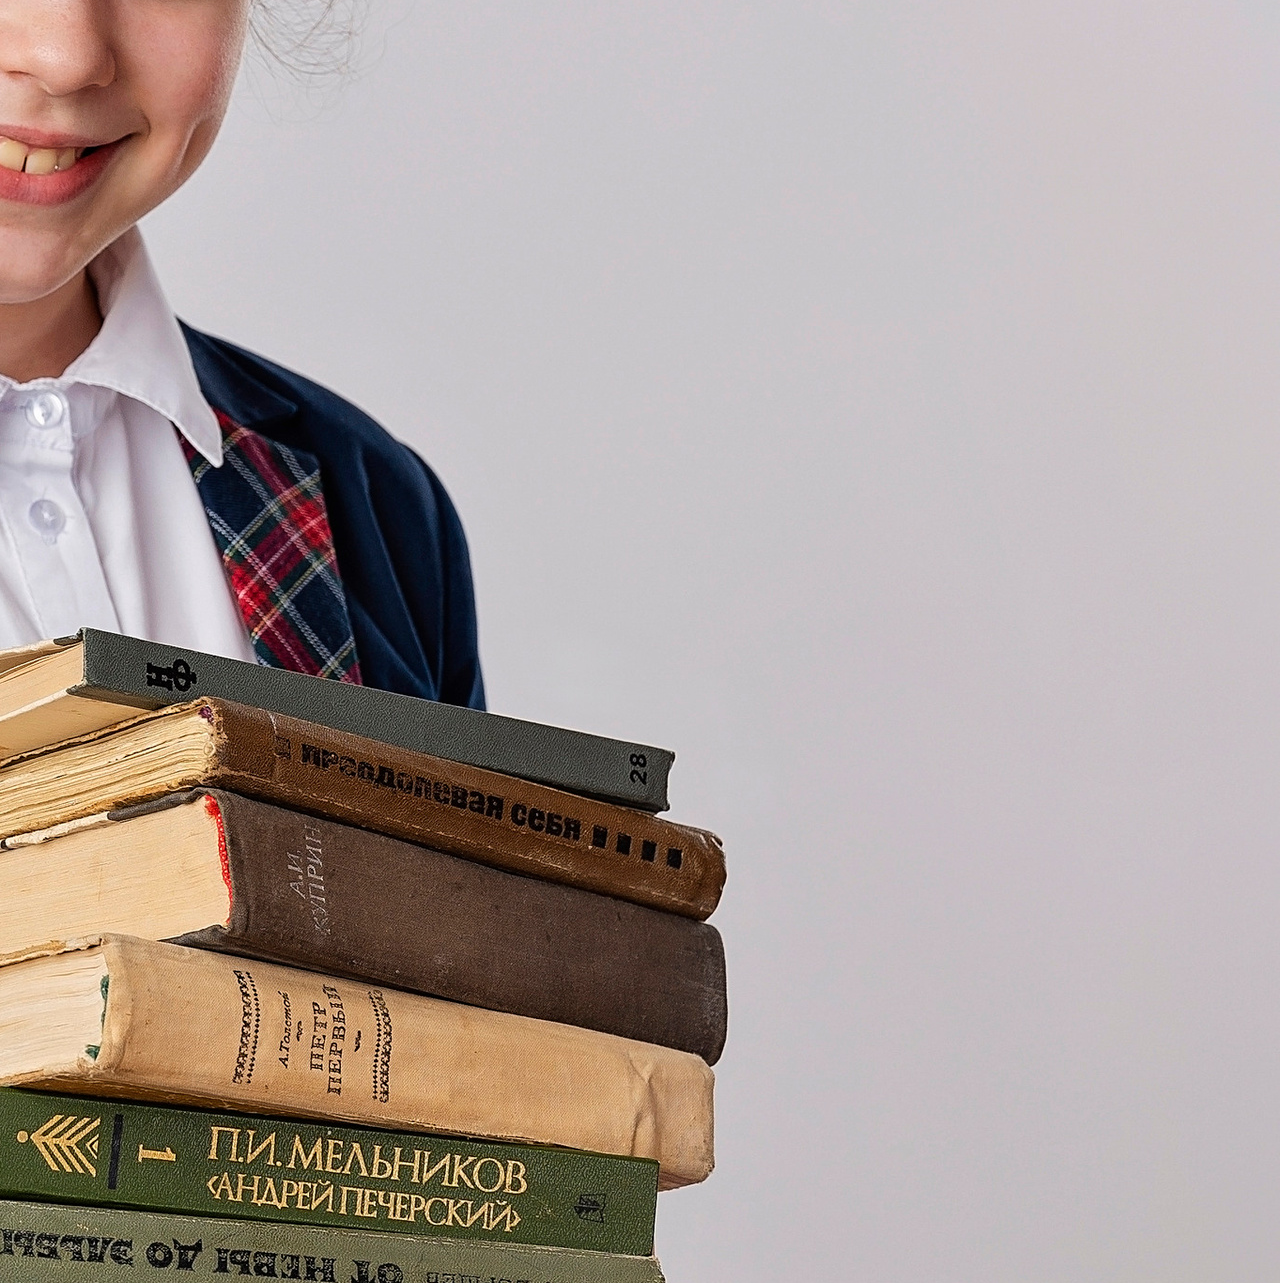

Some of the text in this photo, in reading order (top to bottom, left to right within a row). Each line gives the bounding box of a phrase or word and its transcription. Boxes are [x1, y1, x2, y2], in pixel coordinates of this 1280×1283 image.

[629, 753, 648, 786] 28
[309, 1001, 328, 1072] ПЕТР
[322, 983, 347, 1097] ПЕРВЫЙ
[286, 1133, 528, 1195] МЕЛЬНИКОВ
[145, 1237, 204, 1272] ДО
[211, 1247, 338, 1283] НЕВЫ
